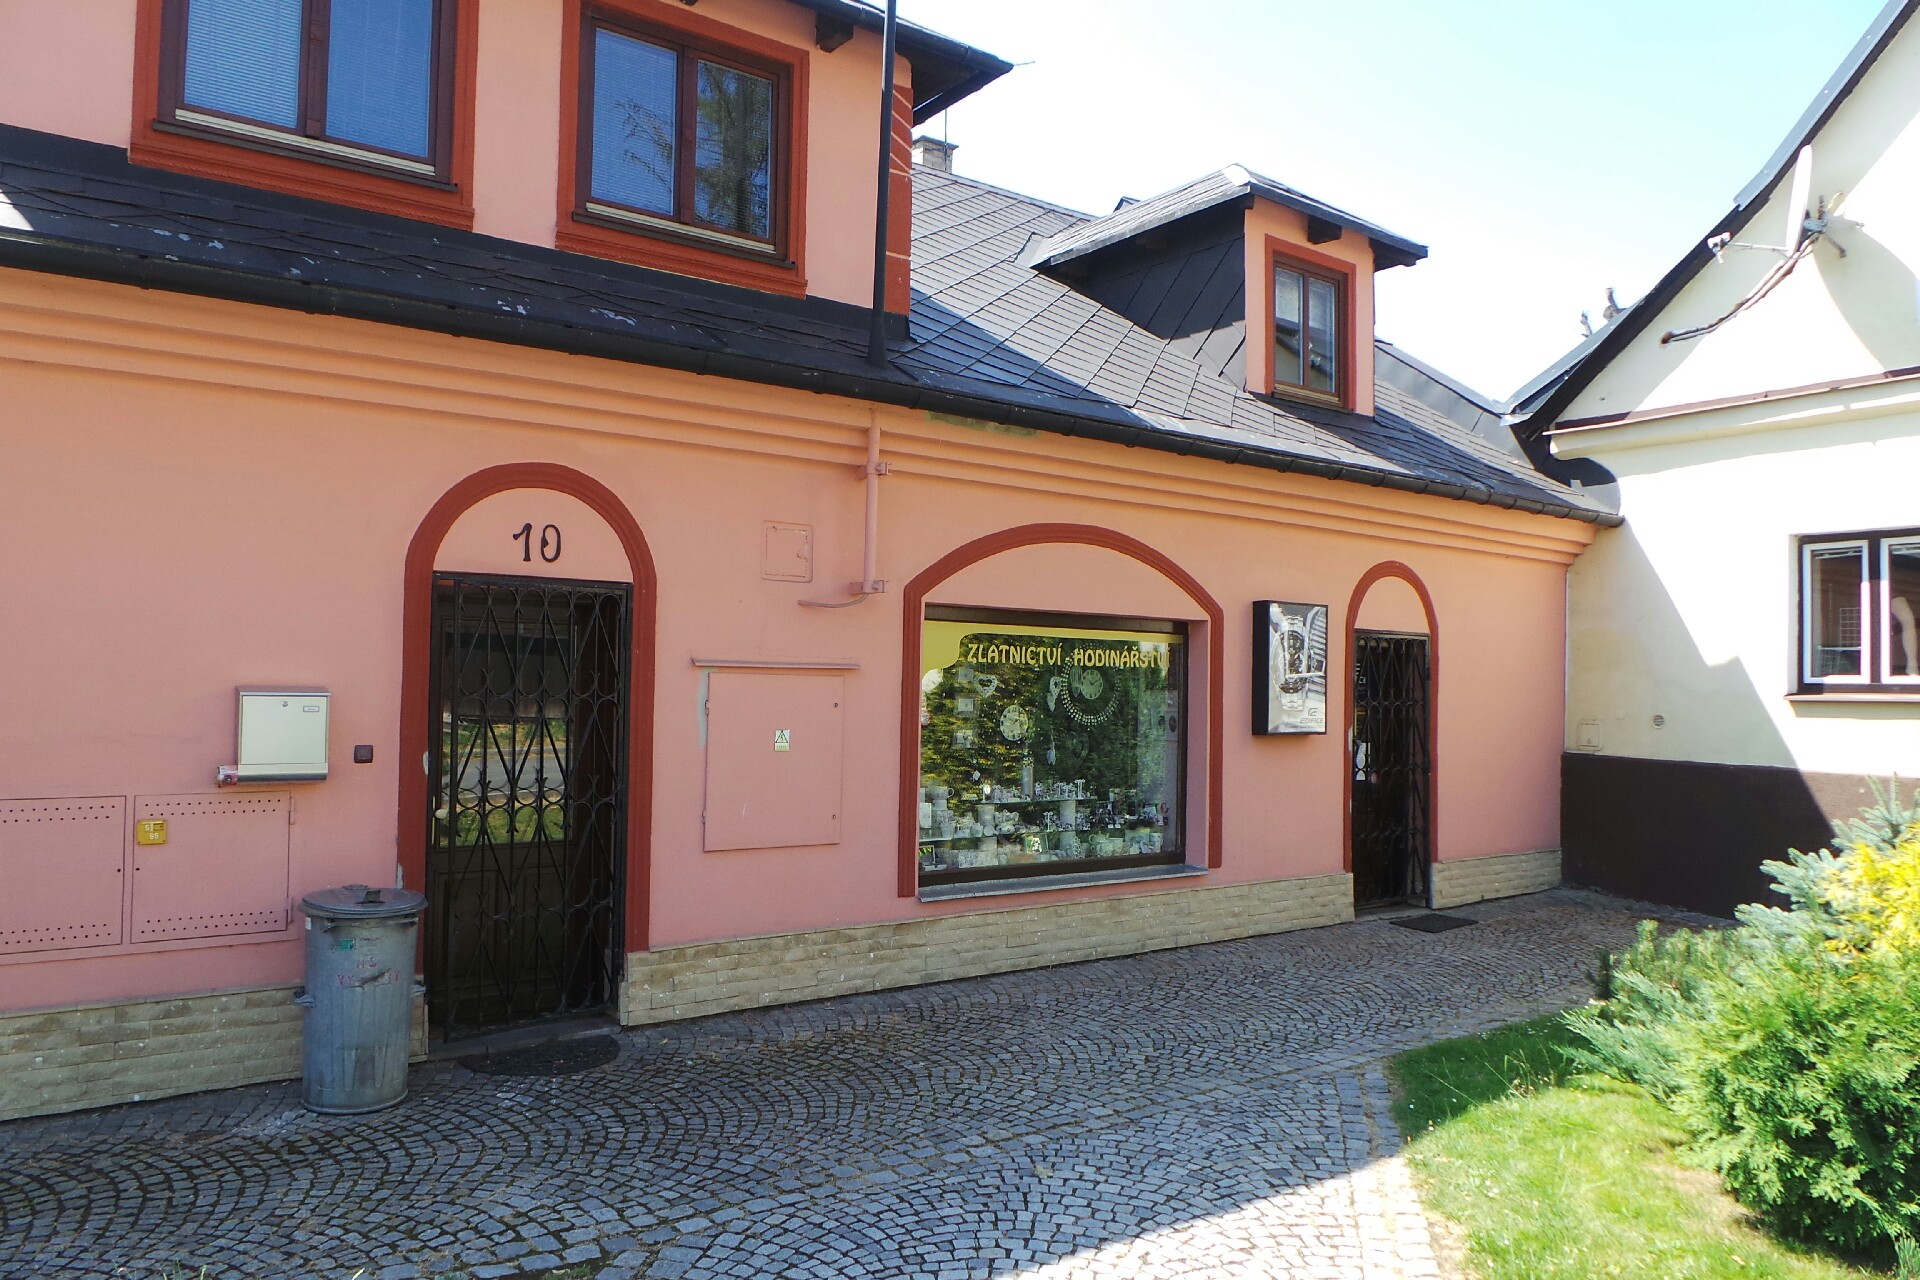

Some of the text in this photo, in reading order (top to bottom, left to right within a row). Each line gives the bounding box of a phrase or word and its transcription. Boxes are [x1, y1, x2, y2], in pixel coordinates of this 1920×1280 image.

[513, 522, 562, 563] 10
[967, 643, 1170, 668] ZLATNICTVÍ HODINÁŘSTVÍ
